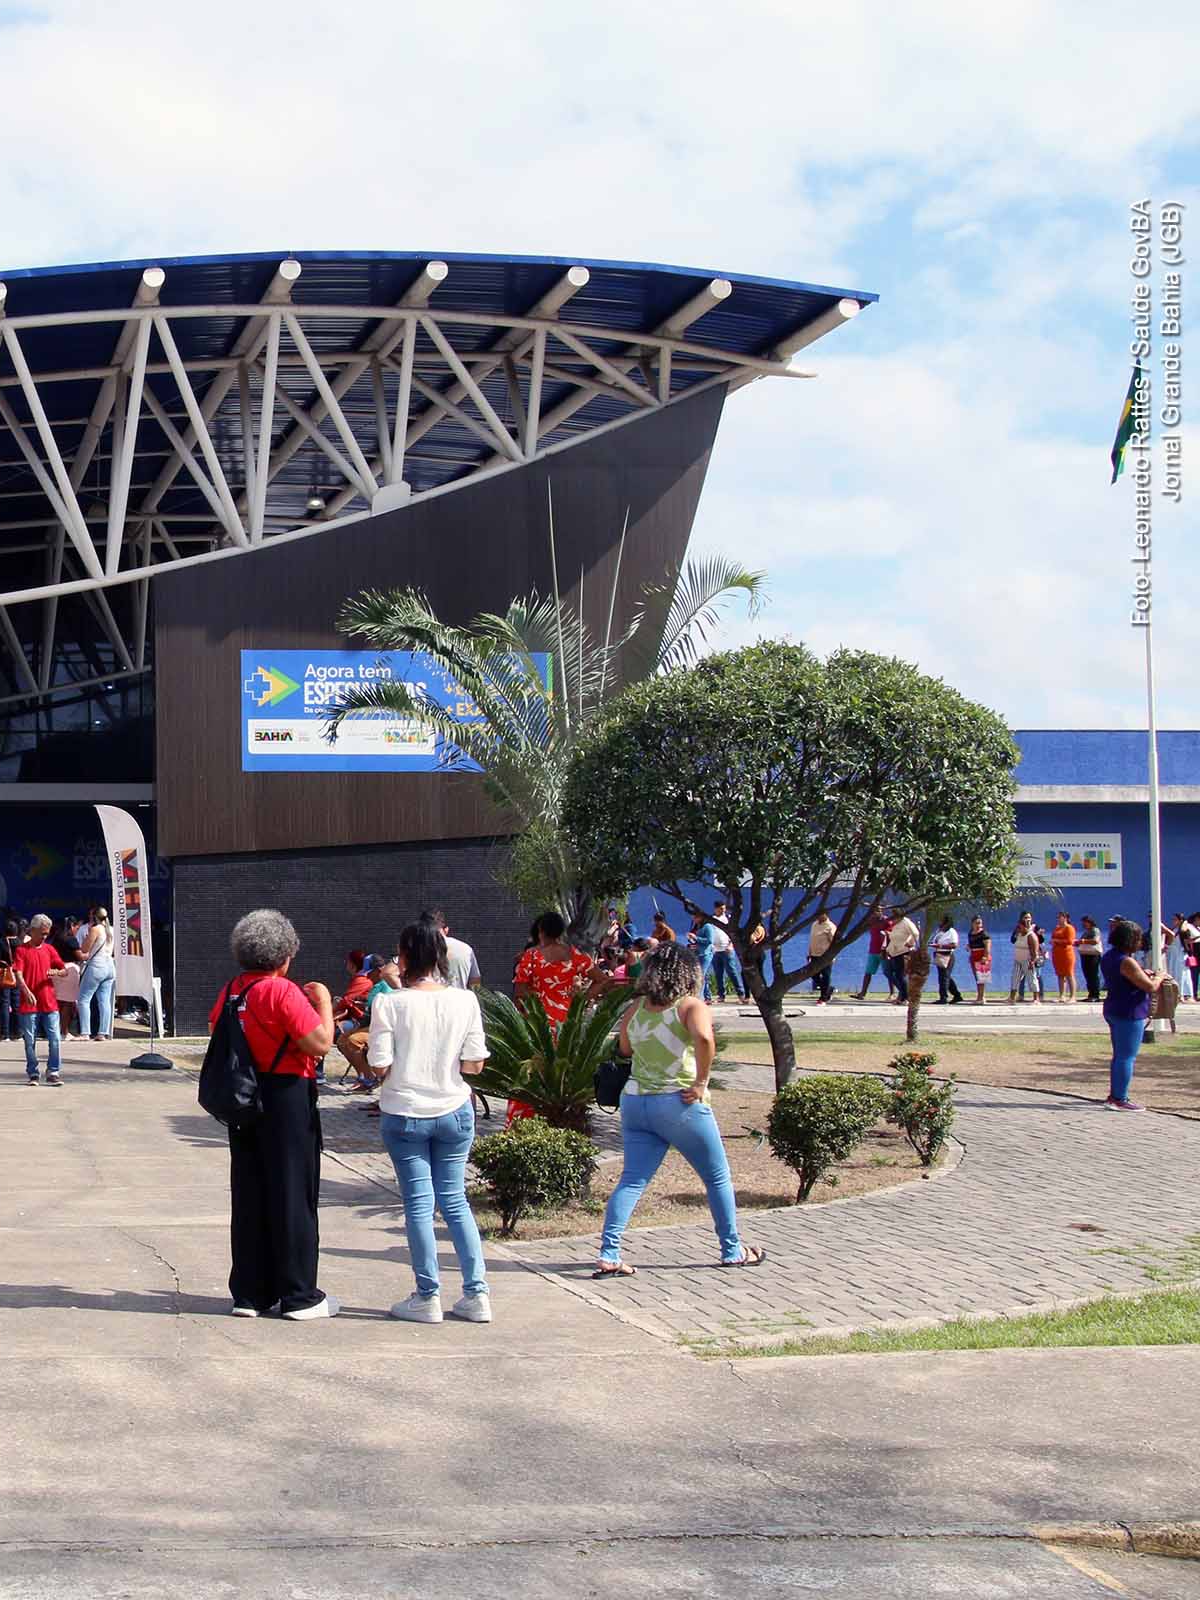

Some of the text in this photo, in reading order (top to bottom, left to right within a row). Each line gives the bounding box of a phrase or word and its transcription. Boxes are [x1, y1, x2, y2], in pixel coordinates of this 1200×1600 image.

[304, 663, 392, 681] Agora tem
[254, 731, 293, 741] BAHIA
[1044, 850, 1118, 869] BRASIL
[114, 850, 128, 956] GOVERNO DO ESTADO
